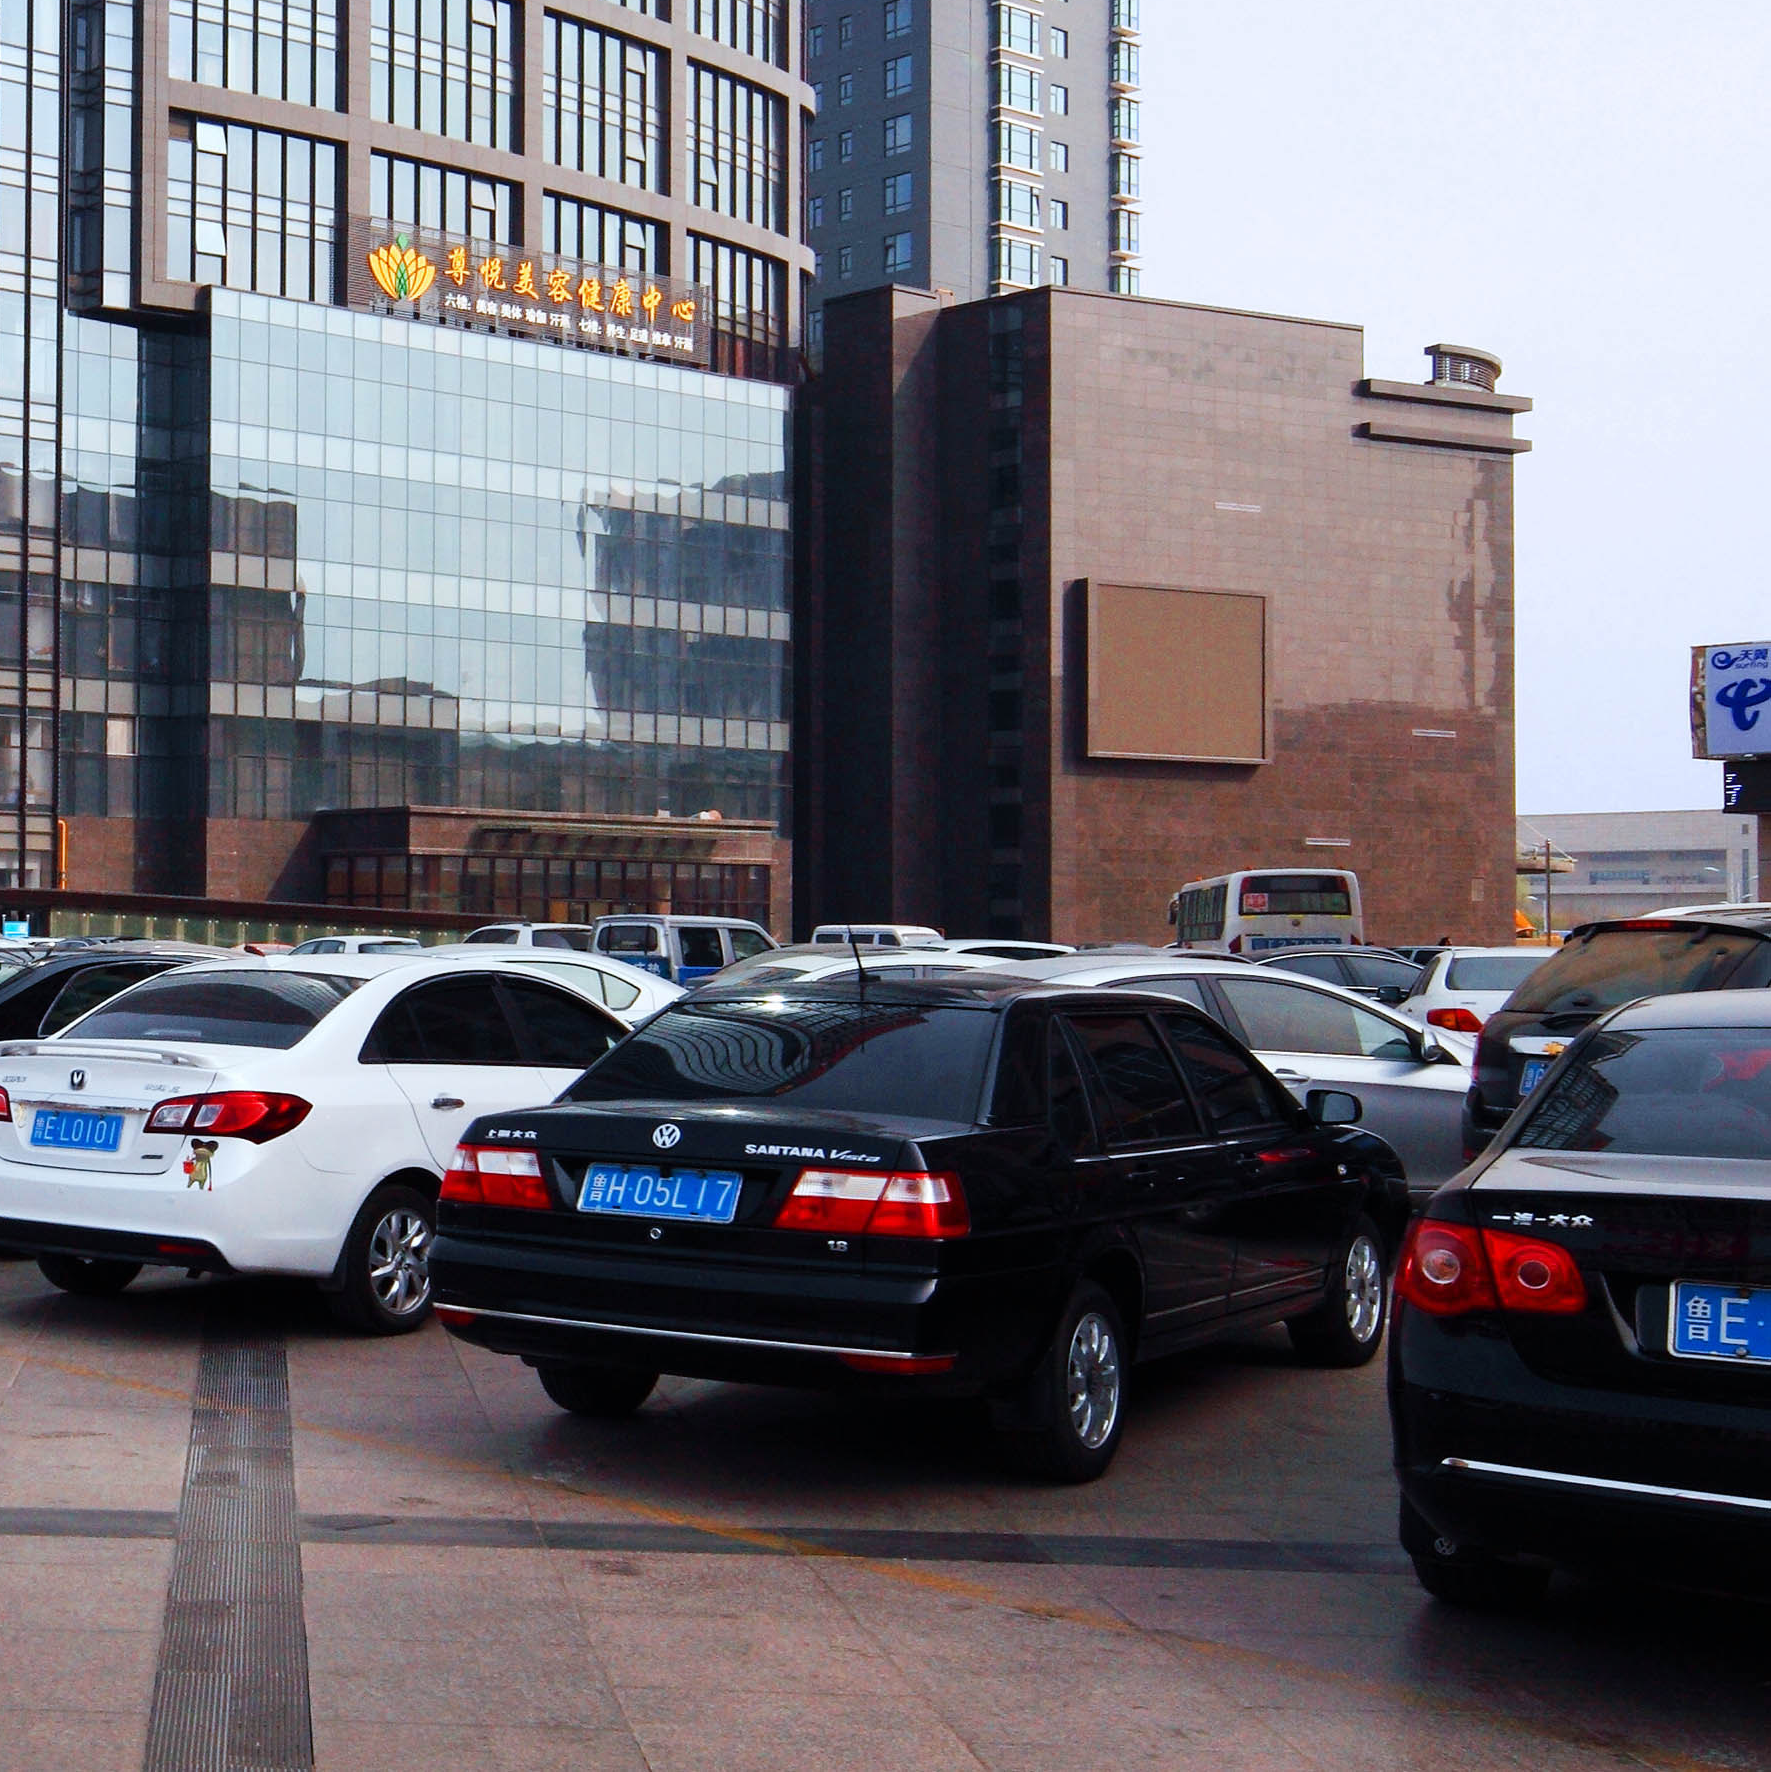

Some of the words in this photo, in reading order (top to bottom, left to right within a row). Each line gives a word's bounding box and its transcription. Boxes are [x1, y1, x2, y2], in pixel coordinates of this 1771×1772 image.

[443, 246, 696, 323] 尊悦美容健康中心
[1740, 648, 1769, 661] 天翼
[1735, 660, 1769, 670] surfing
[744, 1143, 826, 1159] SANTANA
[829, 1149, 881, 1163] Vista
